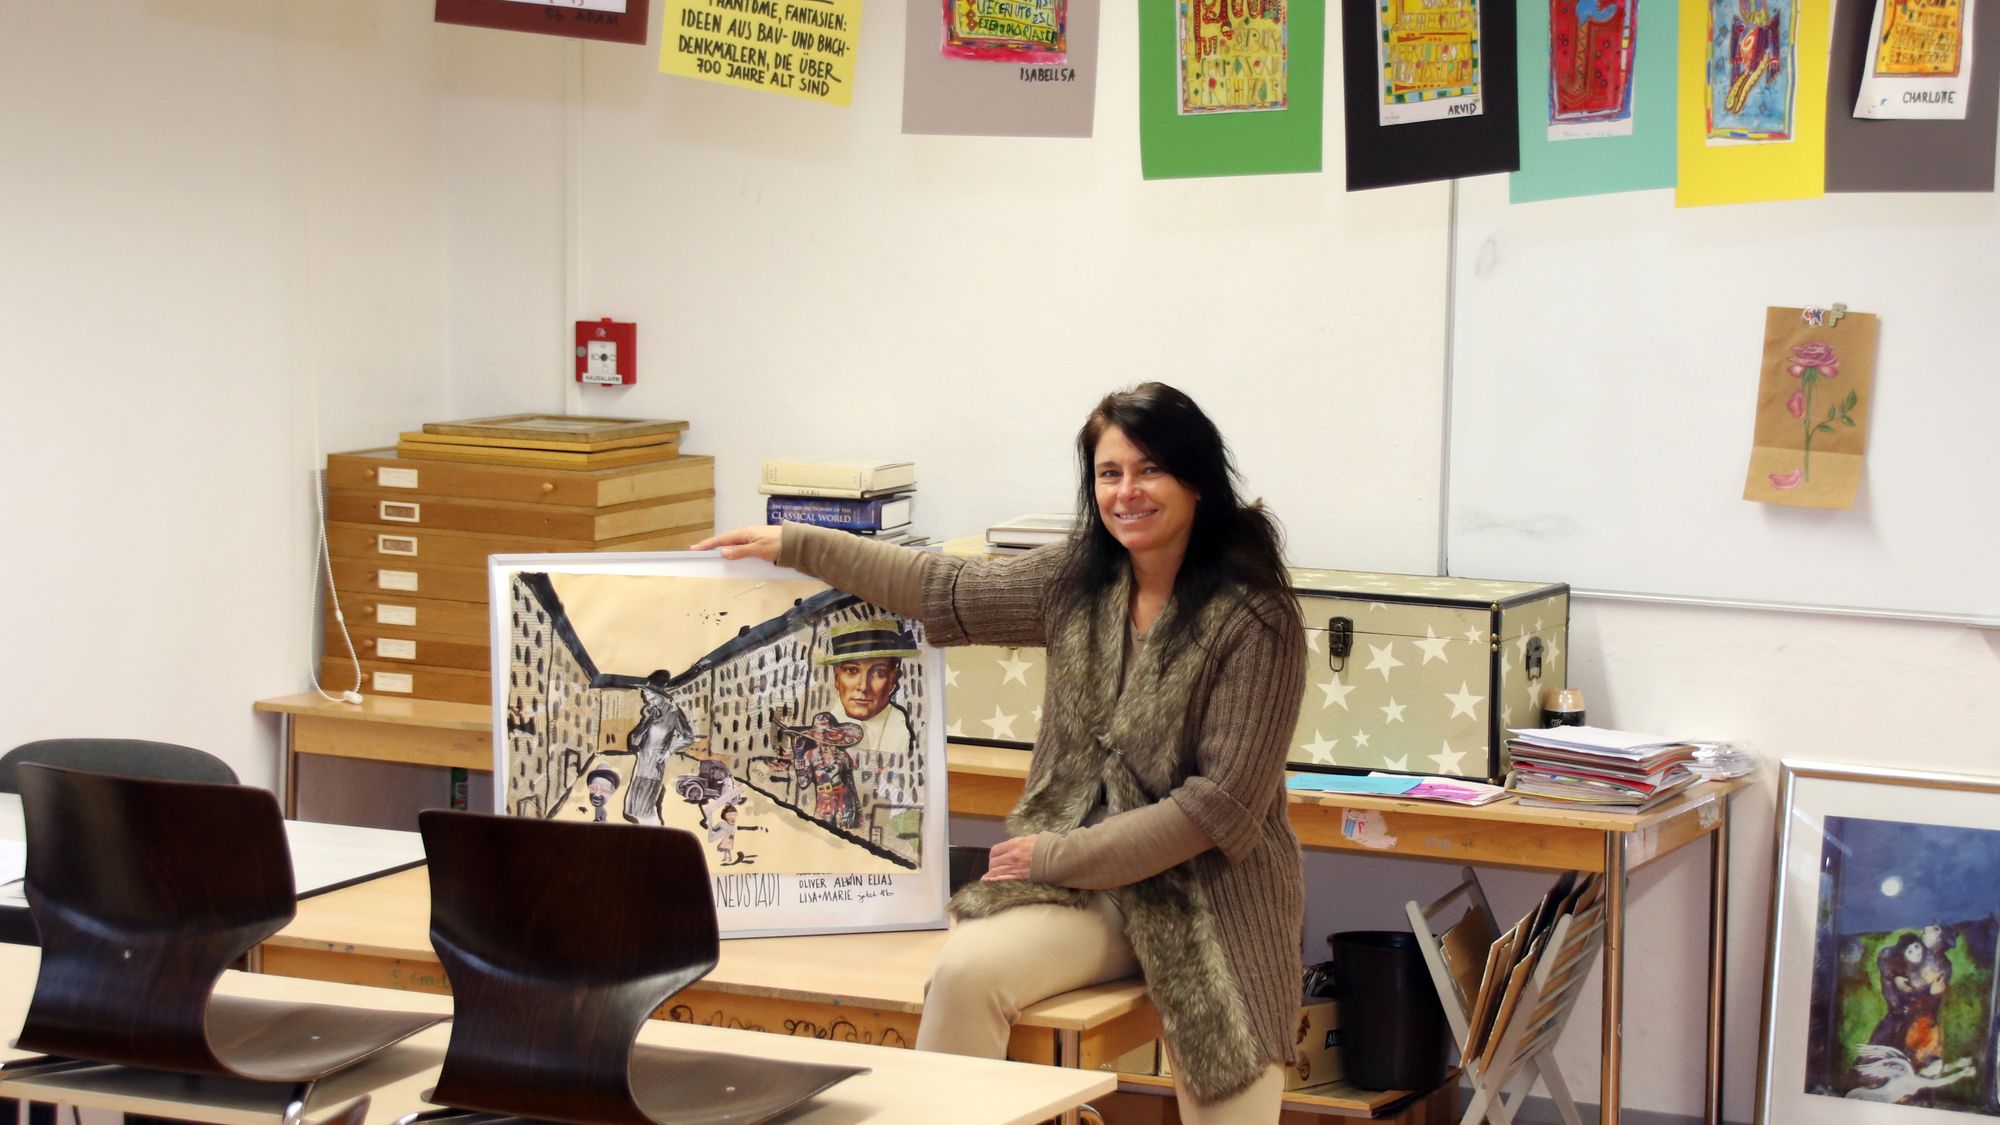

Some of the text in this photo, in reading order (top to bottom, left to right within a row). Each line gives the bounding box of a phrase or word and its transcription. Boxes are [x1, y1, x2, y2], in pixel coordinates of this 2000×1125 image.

[785, 5, 847, 32] FANTASIEN:
[681, 9, 722, 33] IDEEN
[727, 19, 752, 40] AUS
[792, 31, 814, 50] UND
[678, 34, 842, 83] DENKMÄLERN, DIE ÜBER
[697, 57, 830, 97] 700 JAHRE ALT SIND
[1902, 91, 1957, 104] CHARLOTTE
[1448, 103, 1477, 115] ARVID
[771, 511, 852, 524] CLASSICAL WORLD
[799, 878, 827, 889] OLIVER
[868, 874, 893, 886] ELIAS
